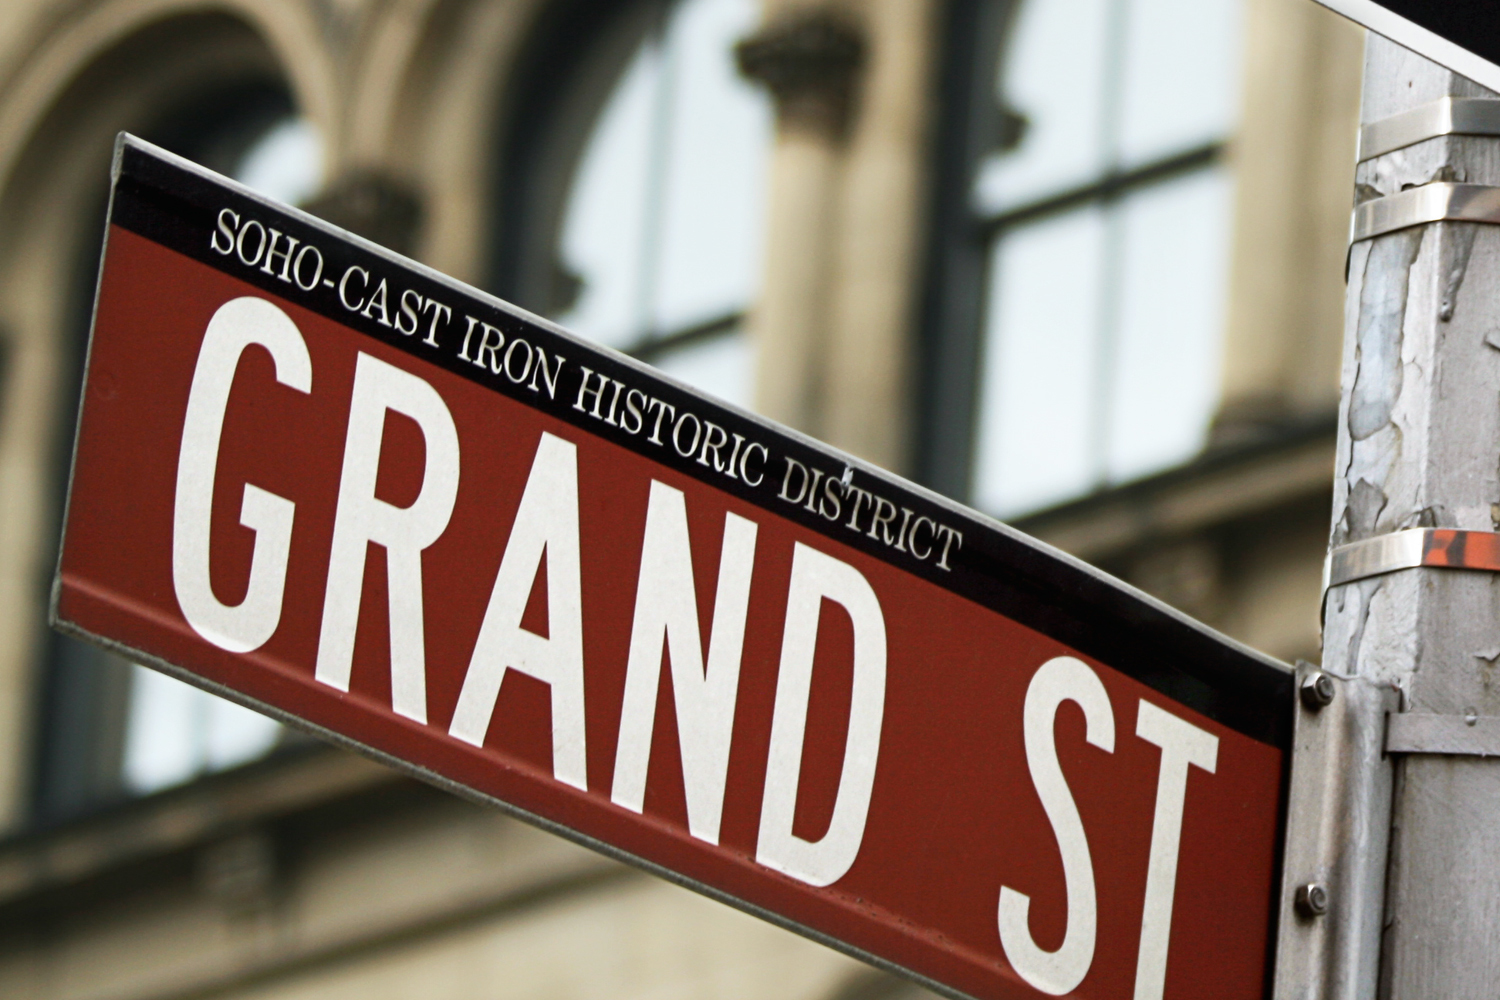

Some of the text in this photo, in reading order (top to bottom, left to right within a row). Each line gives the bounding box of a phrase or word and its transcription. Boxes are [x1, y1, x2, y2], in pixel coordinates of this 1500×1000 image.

[172, 296, 1219, 1000] GRAND ST
[210, 207, 963, 572] SOHO-CAST IRON HISTORIC DISTRICT
